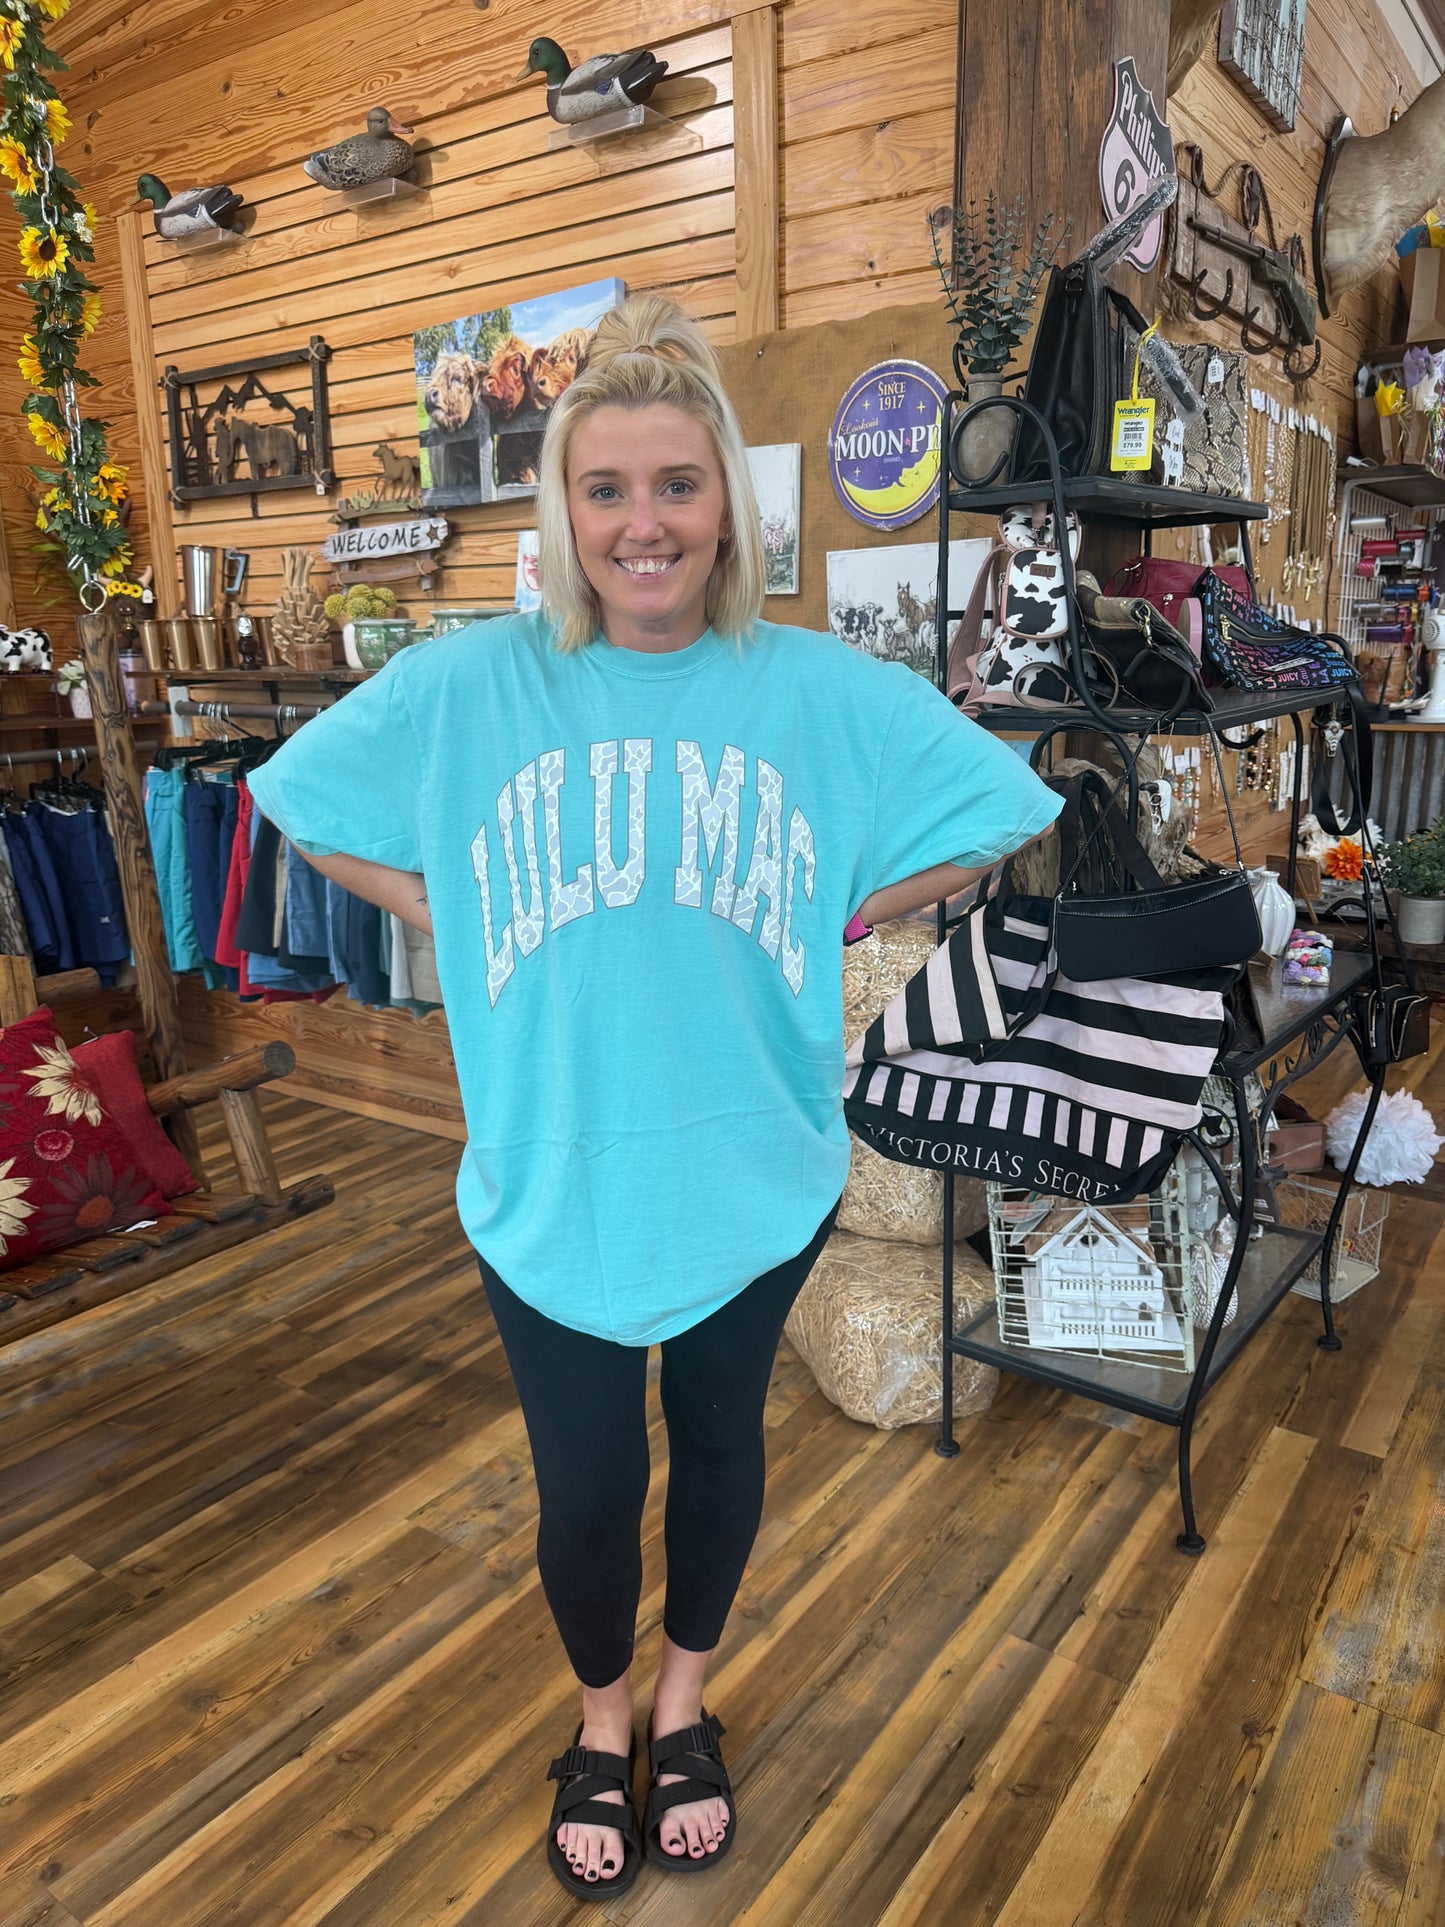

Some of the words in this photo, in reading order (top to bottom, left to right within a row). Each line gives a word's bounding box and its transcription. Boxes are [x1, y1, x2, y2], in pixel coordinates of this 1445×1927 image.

[1119, 70, 1167, 179] Phillips
[878, 381, 907, 397] SINCE
[879, 395, 905, 412] 1917
[1117, 406, 1150, 418] Wrangler
[842, 417, 880, 435] Lookout
[835, 427, 906, 462] MOON
[332, 526, 422, 555] WELCOME
[1277, 672, 1299, 683] JUICY
[1331, 668, 1354, 678] JUICY
[470, 738, 653, 1013] LULU
[673, 739, 816, 1000] MAC
[865, 1122, 1024, 1178] VICTORIA'S
[1034, 1159, 1121, 1202] SECRE
